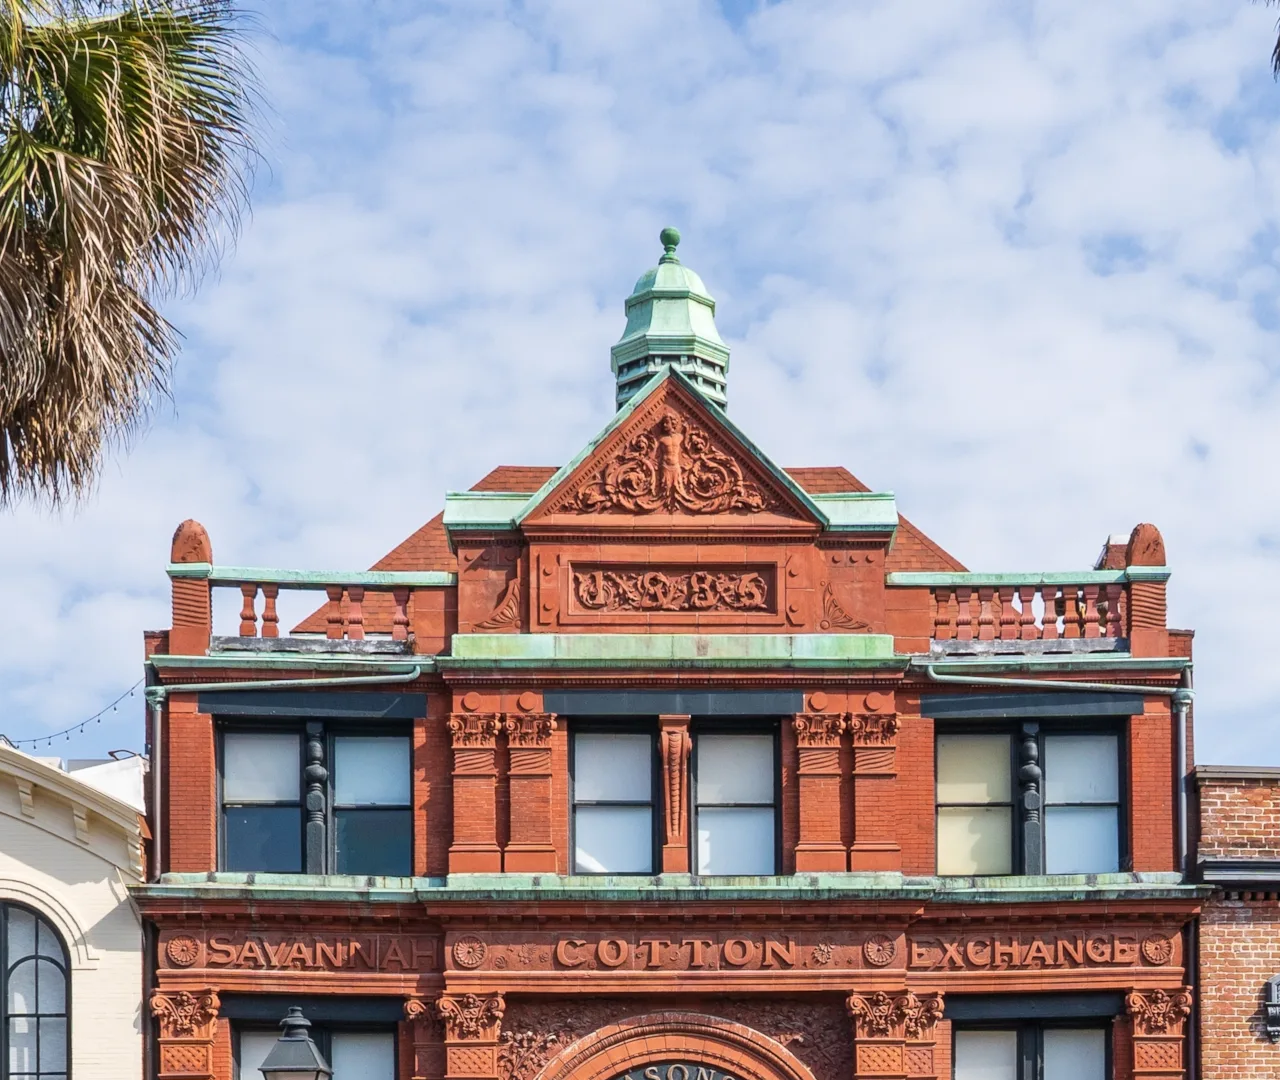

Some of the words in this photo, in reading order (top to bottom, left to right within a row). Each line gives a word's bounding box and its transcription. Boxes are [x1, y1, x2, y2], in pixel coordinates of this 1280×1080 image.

[208, 935, 438, 968] SAVANNAH
[556, 937, 797, 967] COTTON
[909, 936, 1136, 967] EXCHANGE
